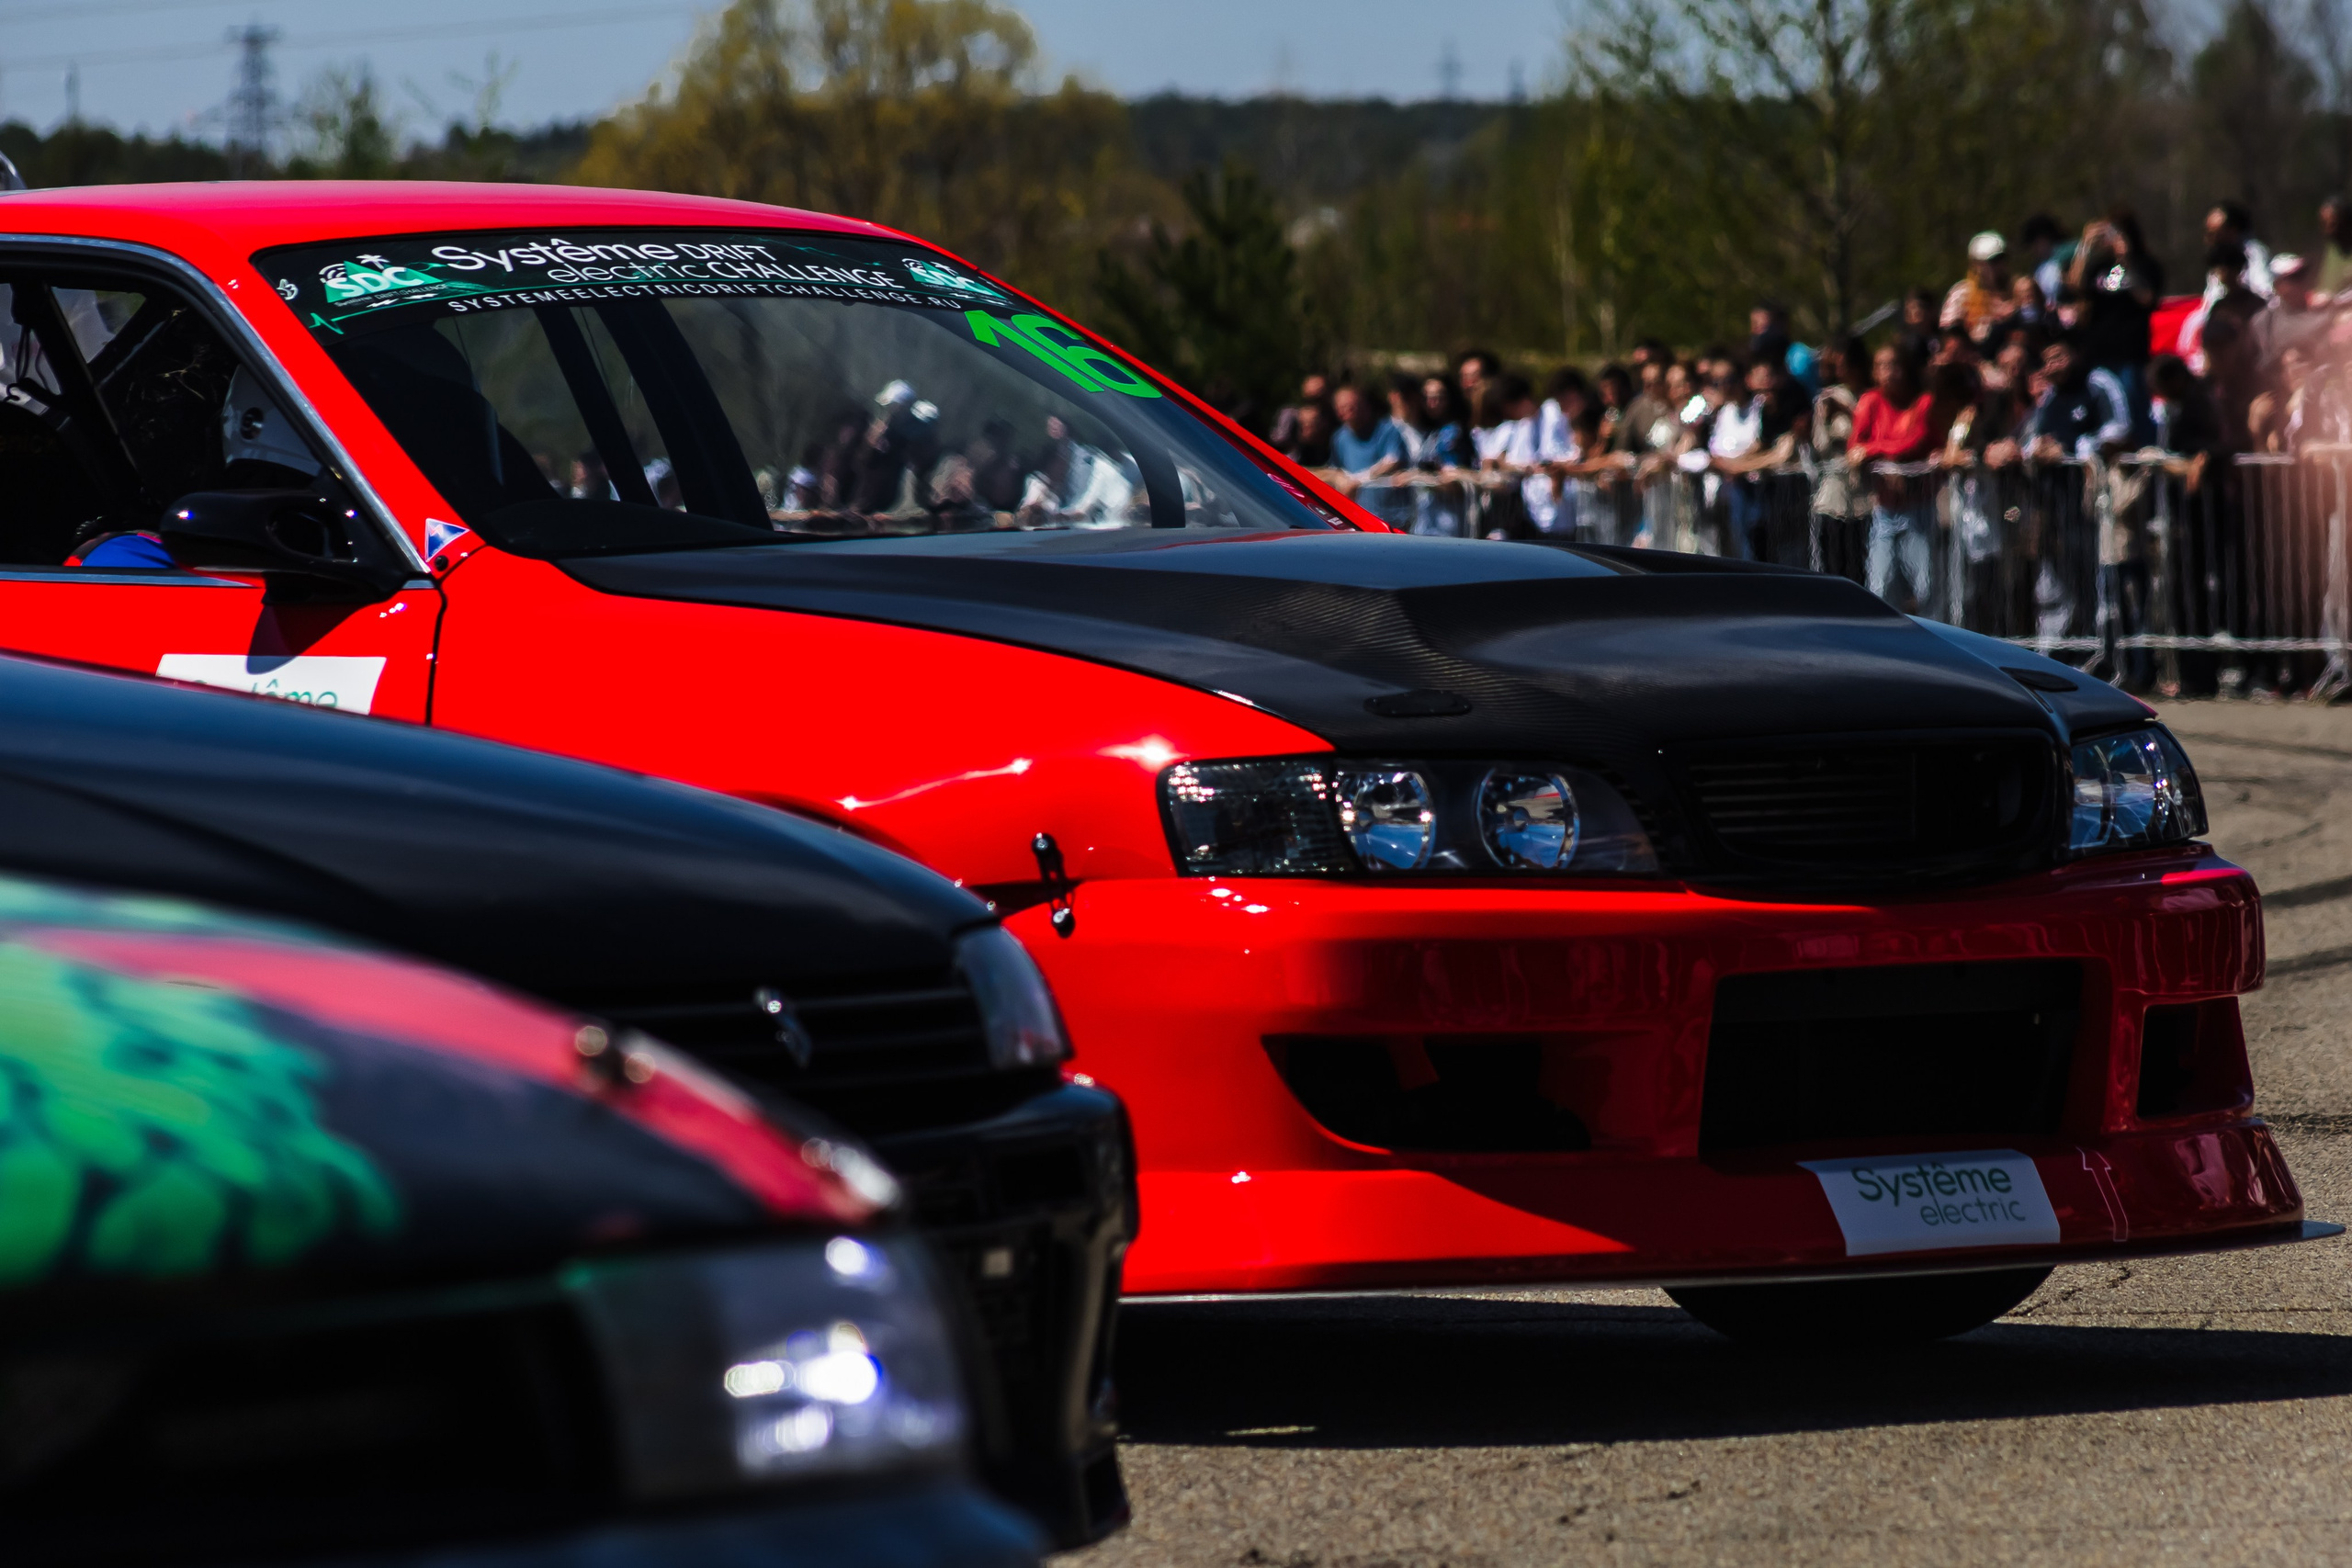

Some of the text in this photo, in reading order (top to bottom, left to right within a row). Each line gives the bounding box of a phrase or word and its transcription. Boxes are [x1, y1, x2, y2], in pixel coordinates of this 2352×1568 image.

[432, 239, 776, 272] Systême DRIFT
[326, 266, 424, 298] SDC
[547, 262, 905, 288] electric CHALLENGE
[910, 267, 994, 295] SDC
[447, 283, 961, 312] SYSTEMEELECTRICDRIFTCHALLENGE.RU
[965, 310, 1162, 398] 16
[1851, 1161, 2012, 1207] Systême
[1920, 1196, 2026, 1226] electric
